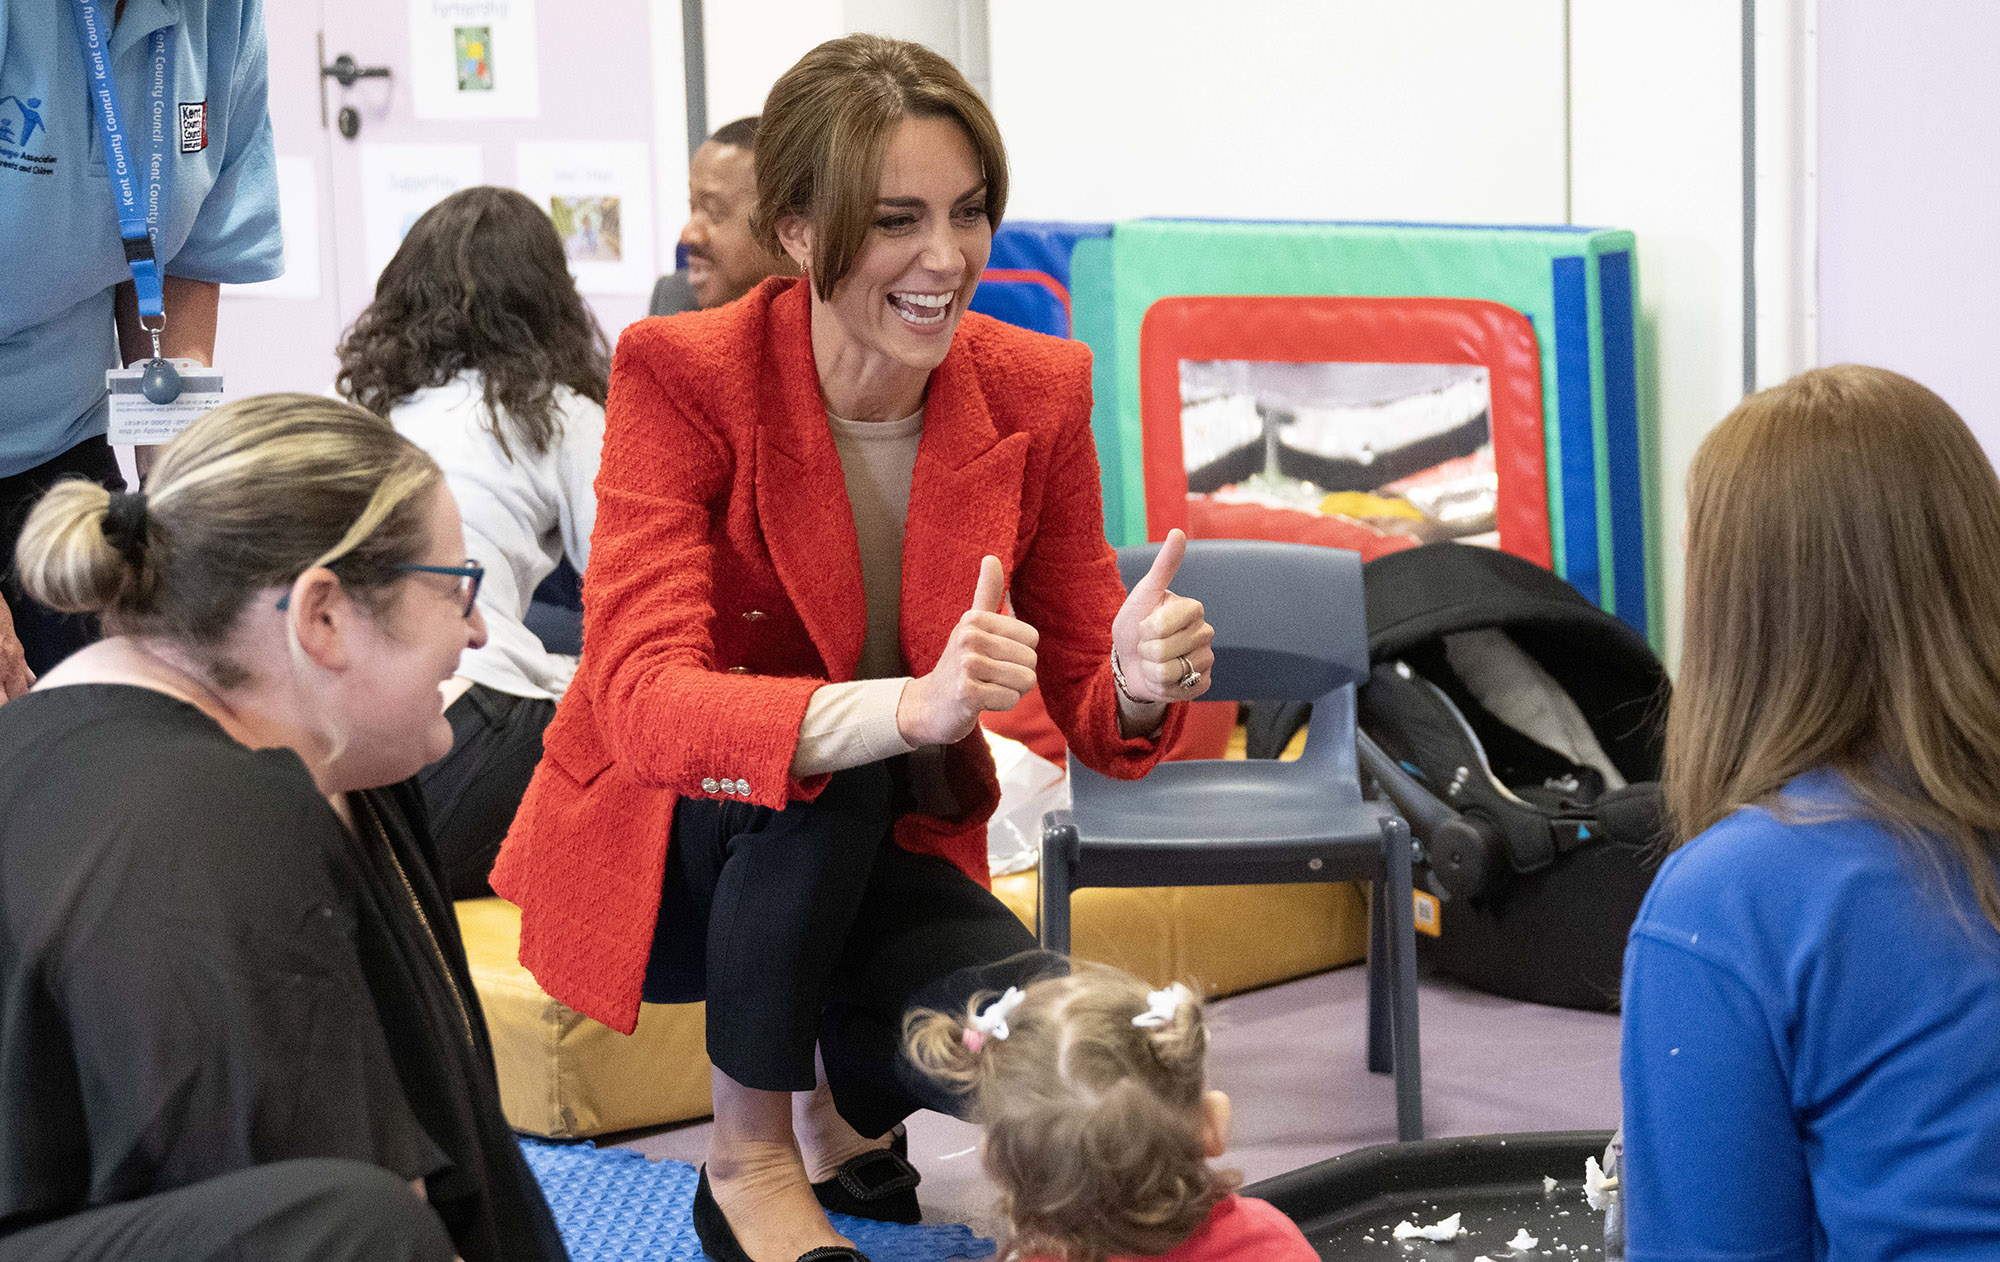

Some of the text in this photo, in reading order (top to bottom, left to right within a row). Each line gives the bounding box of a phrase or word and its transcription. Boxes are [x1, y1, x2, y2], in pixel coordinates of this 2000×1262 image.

[84, 6, 100, 49] County
[91, 50, 107, 80] Kent
[151, 56, 166, 98] County
[152, 100, 166, 142] Council
[182, 106, 201, 120] Kent
[98, 89, 135, 206] Kent County Council
[151, 153, 163, 181] Kent
[146, 183, 161, 224] County
